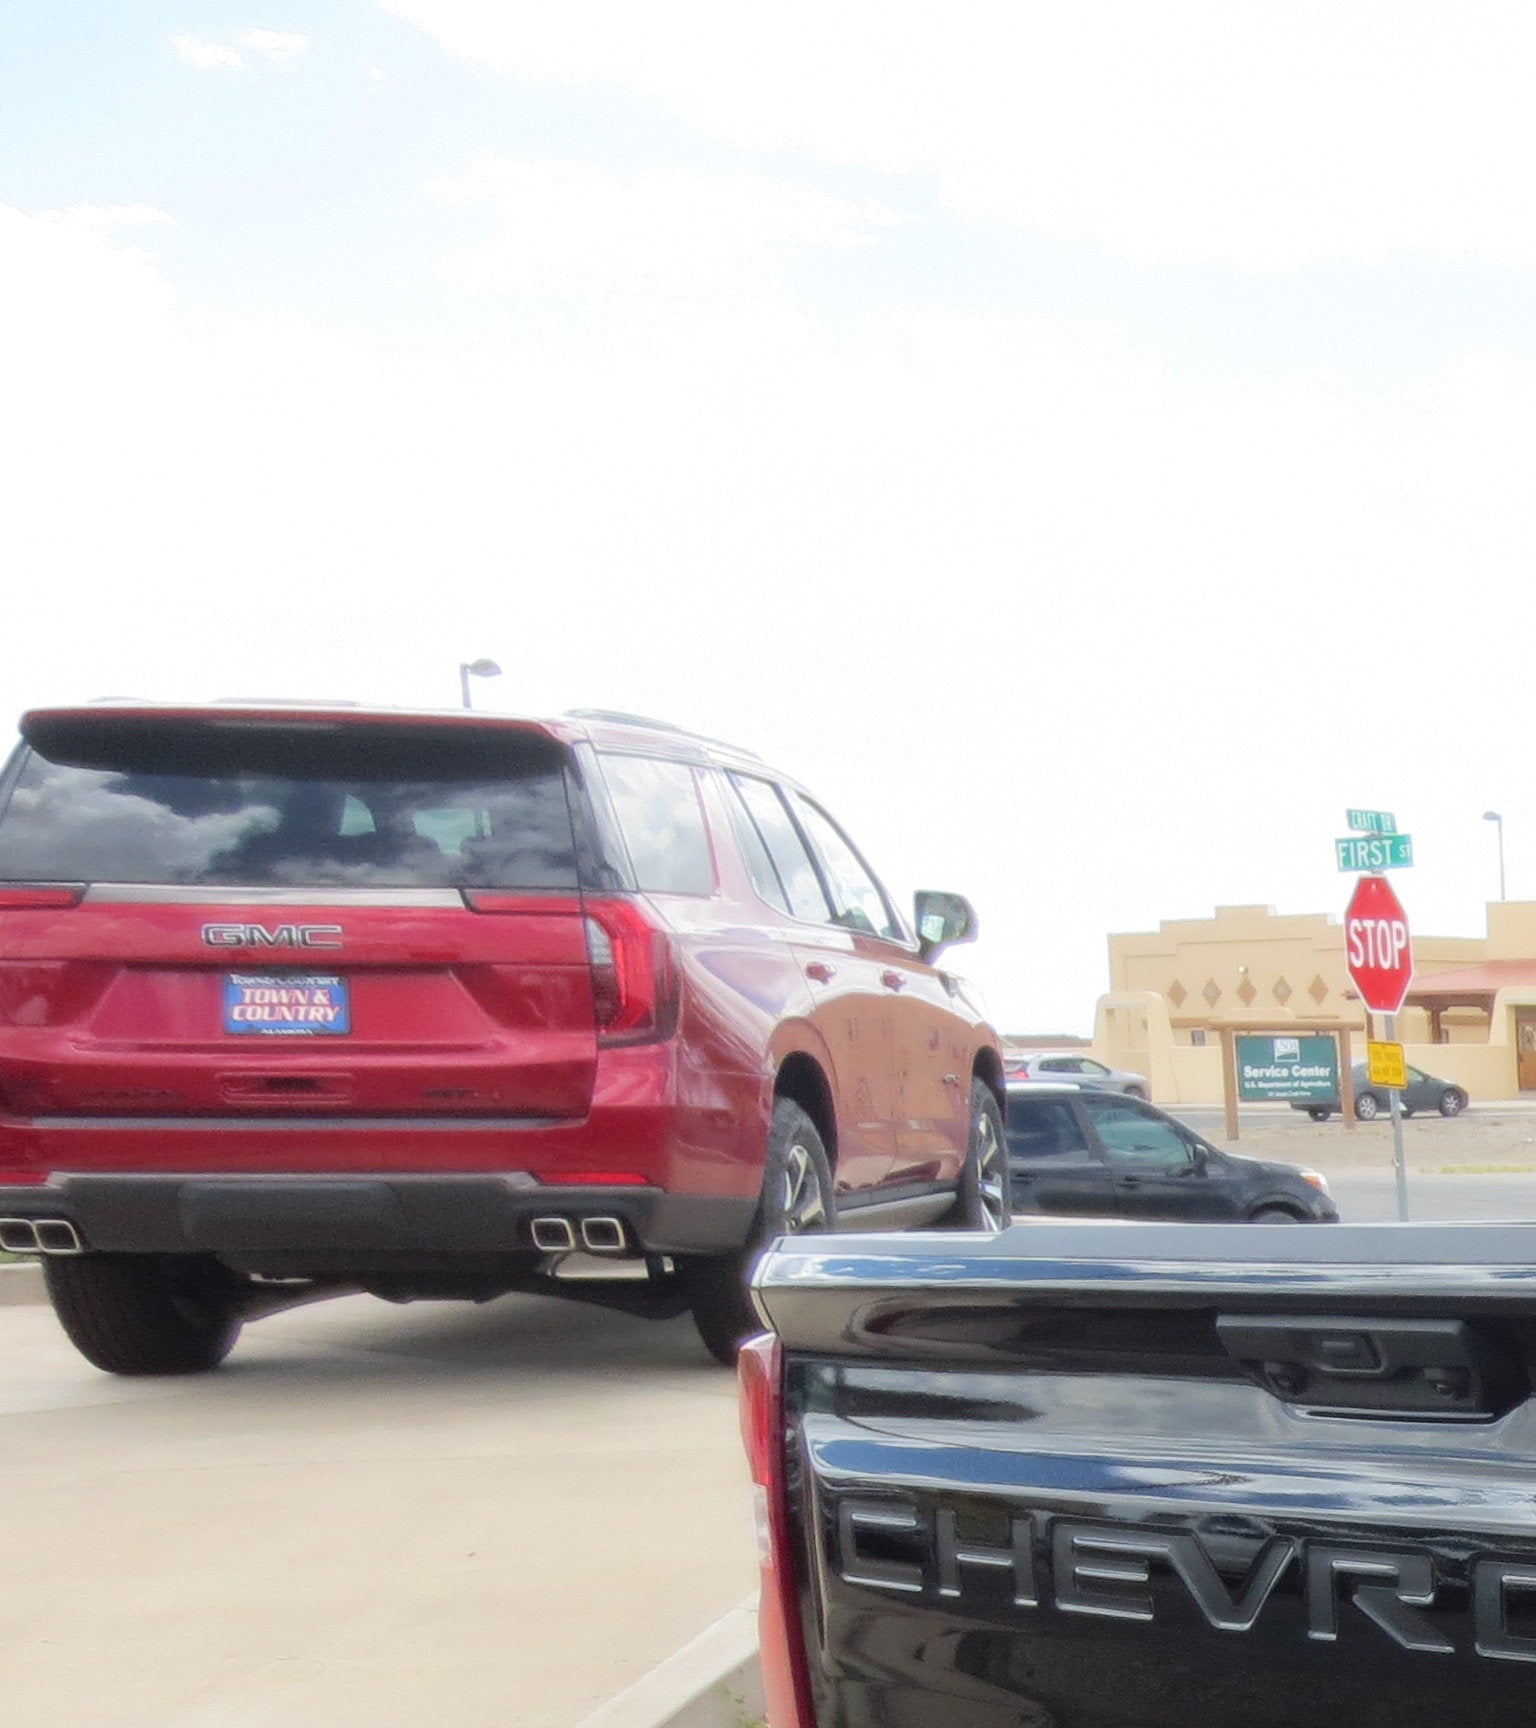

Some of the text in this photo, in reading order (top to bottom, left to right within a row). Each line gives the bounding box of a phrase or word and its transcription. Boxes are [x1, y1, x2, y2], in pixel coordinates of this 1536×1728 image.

[1338, 840, 1411, 868] FIRST ST
[201, 923, 343, 948] GMC
[1350, 919, 1406, 969] STOP
[242, 987, 331, 1005] TOWN &
[231, 1004, 341, 1021] COUNTRY
[1244, 1065, 1331, 1078] Service Center
